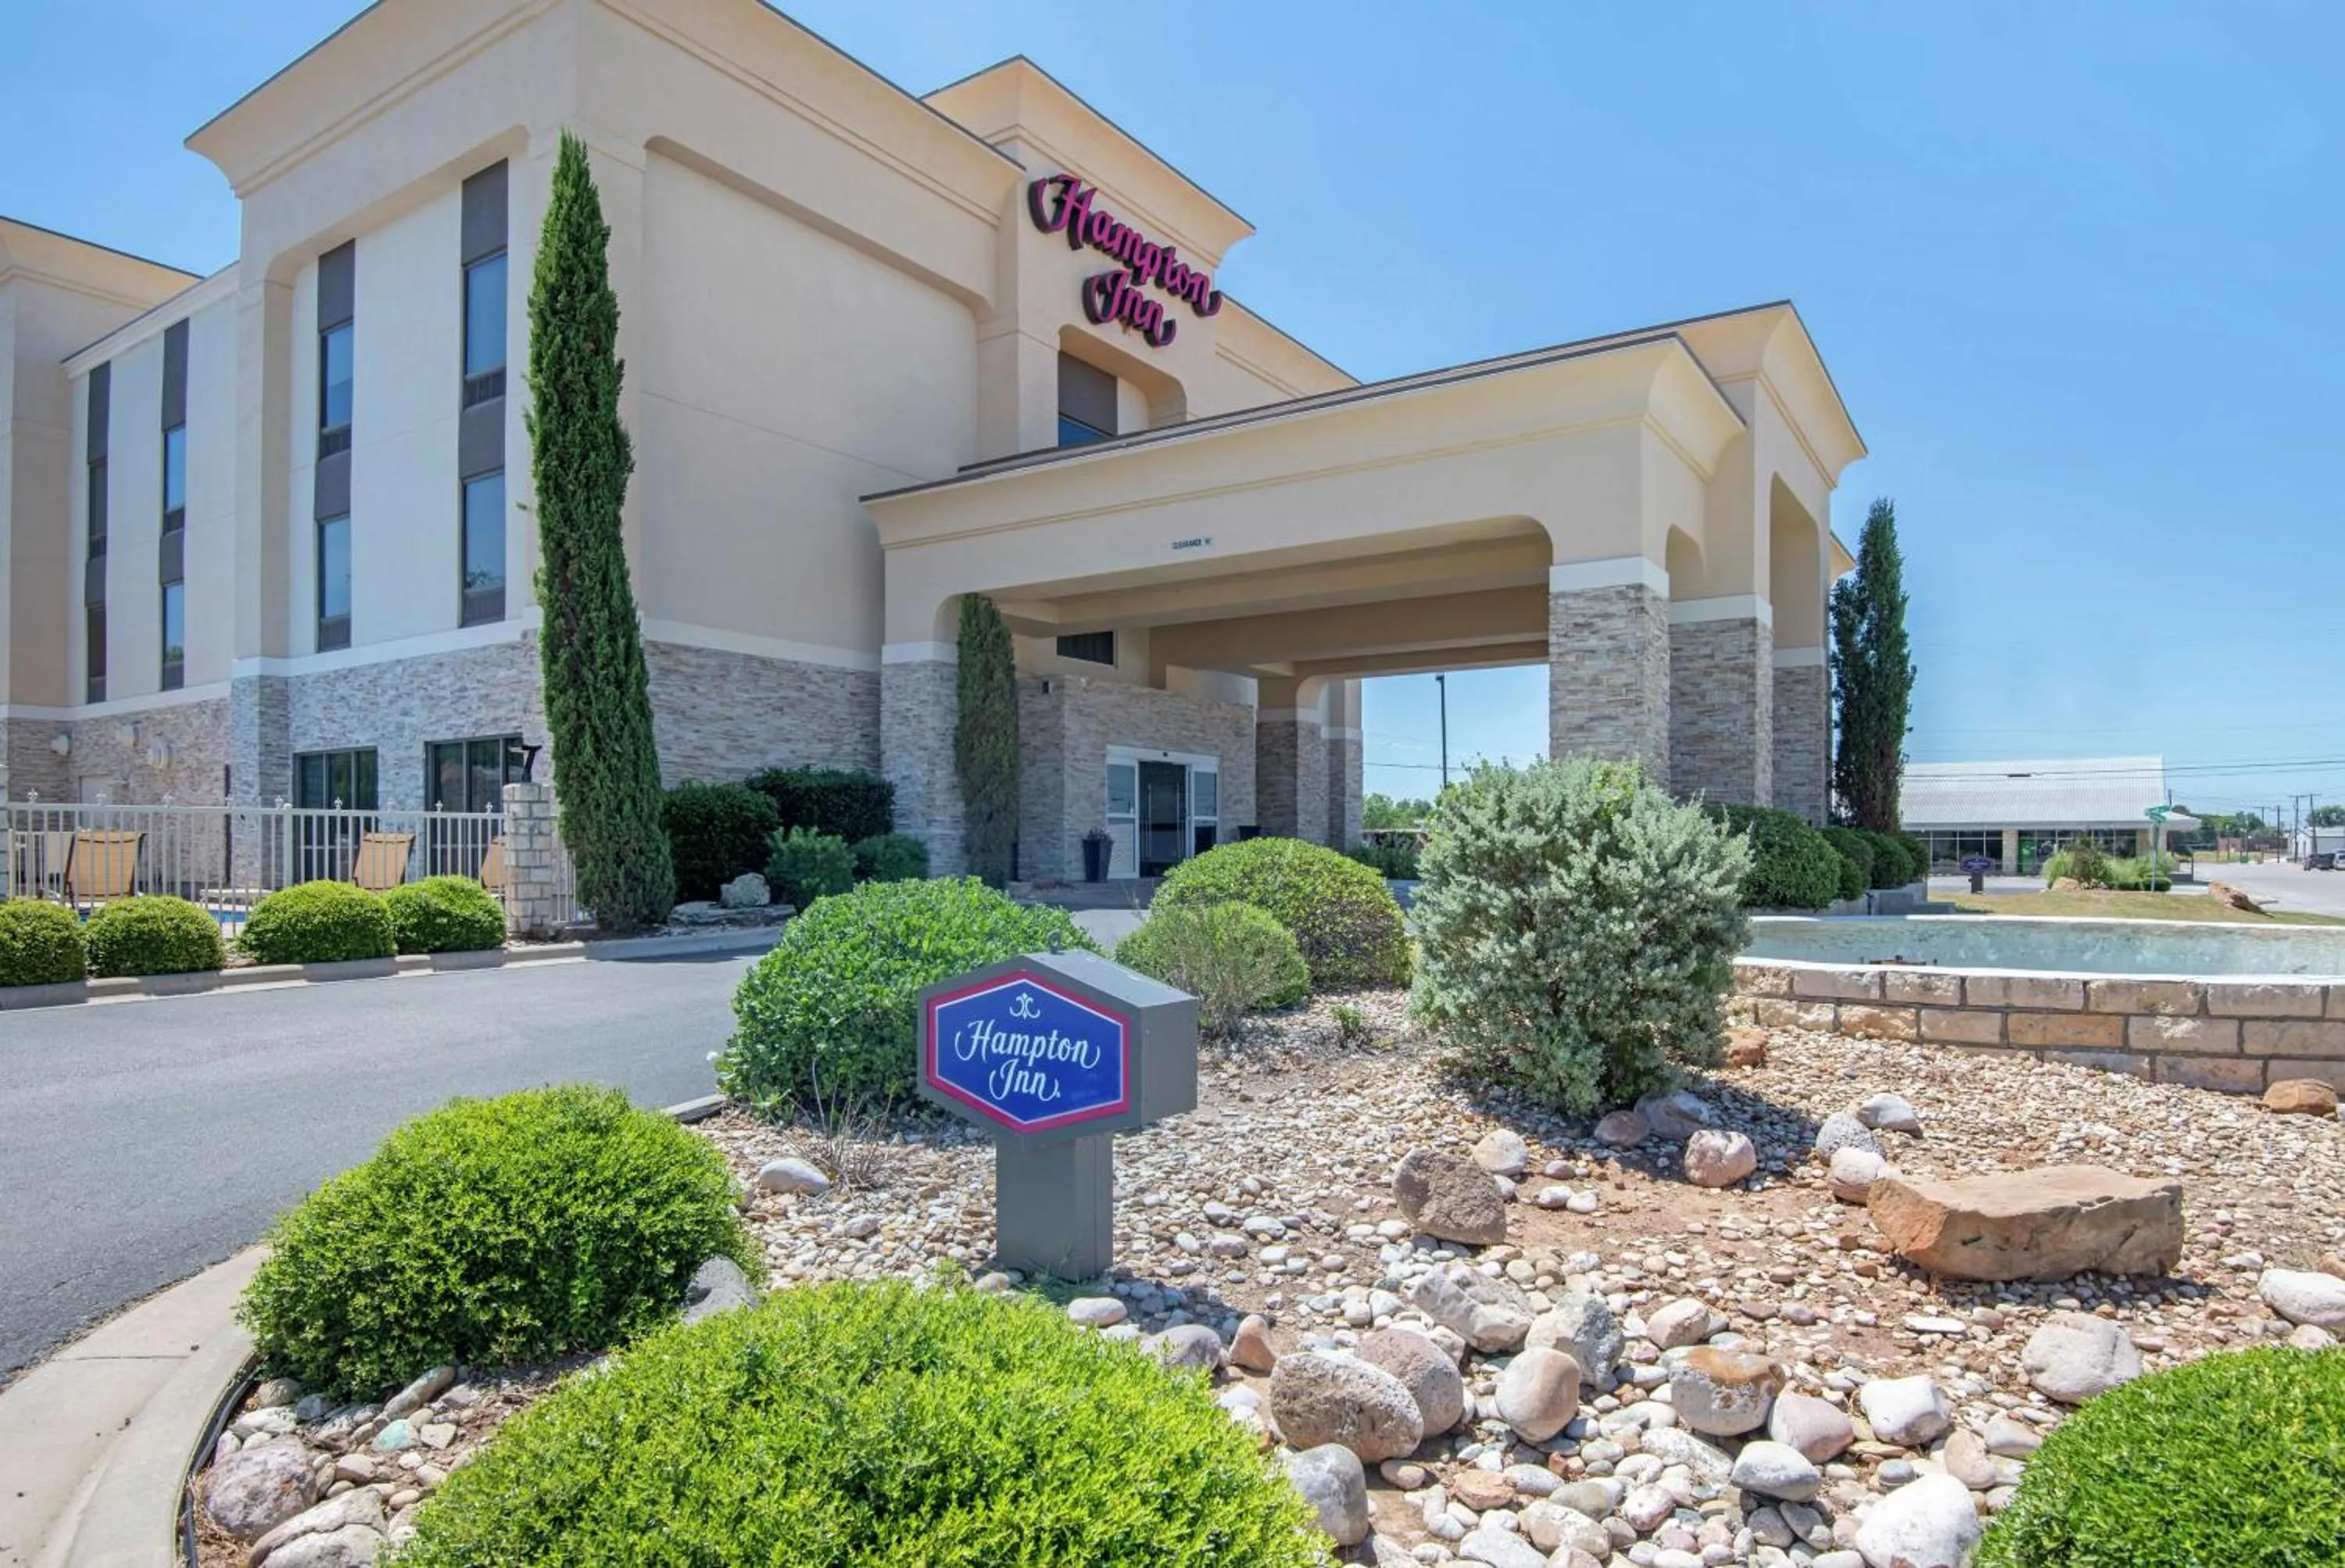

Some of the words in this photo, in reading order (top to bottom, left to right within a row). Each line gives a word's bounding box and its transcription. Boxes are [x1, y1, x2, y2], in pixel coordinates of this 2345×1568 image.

[1028, 174, 1223, 317] Hampton
[1082, 270, 1176, 348] Inn
[955, 1019, 1101, 1069] Hampton
[989, 1058, 1059, 1101] Inn
